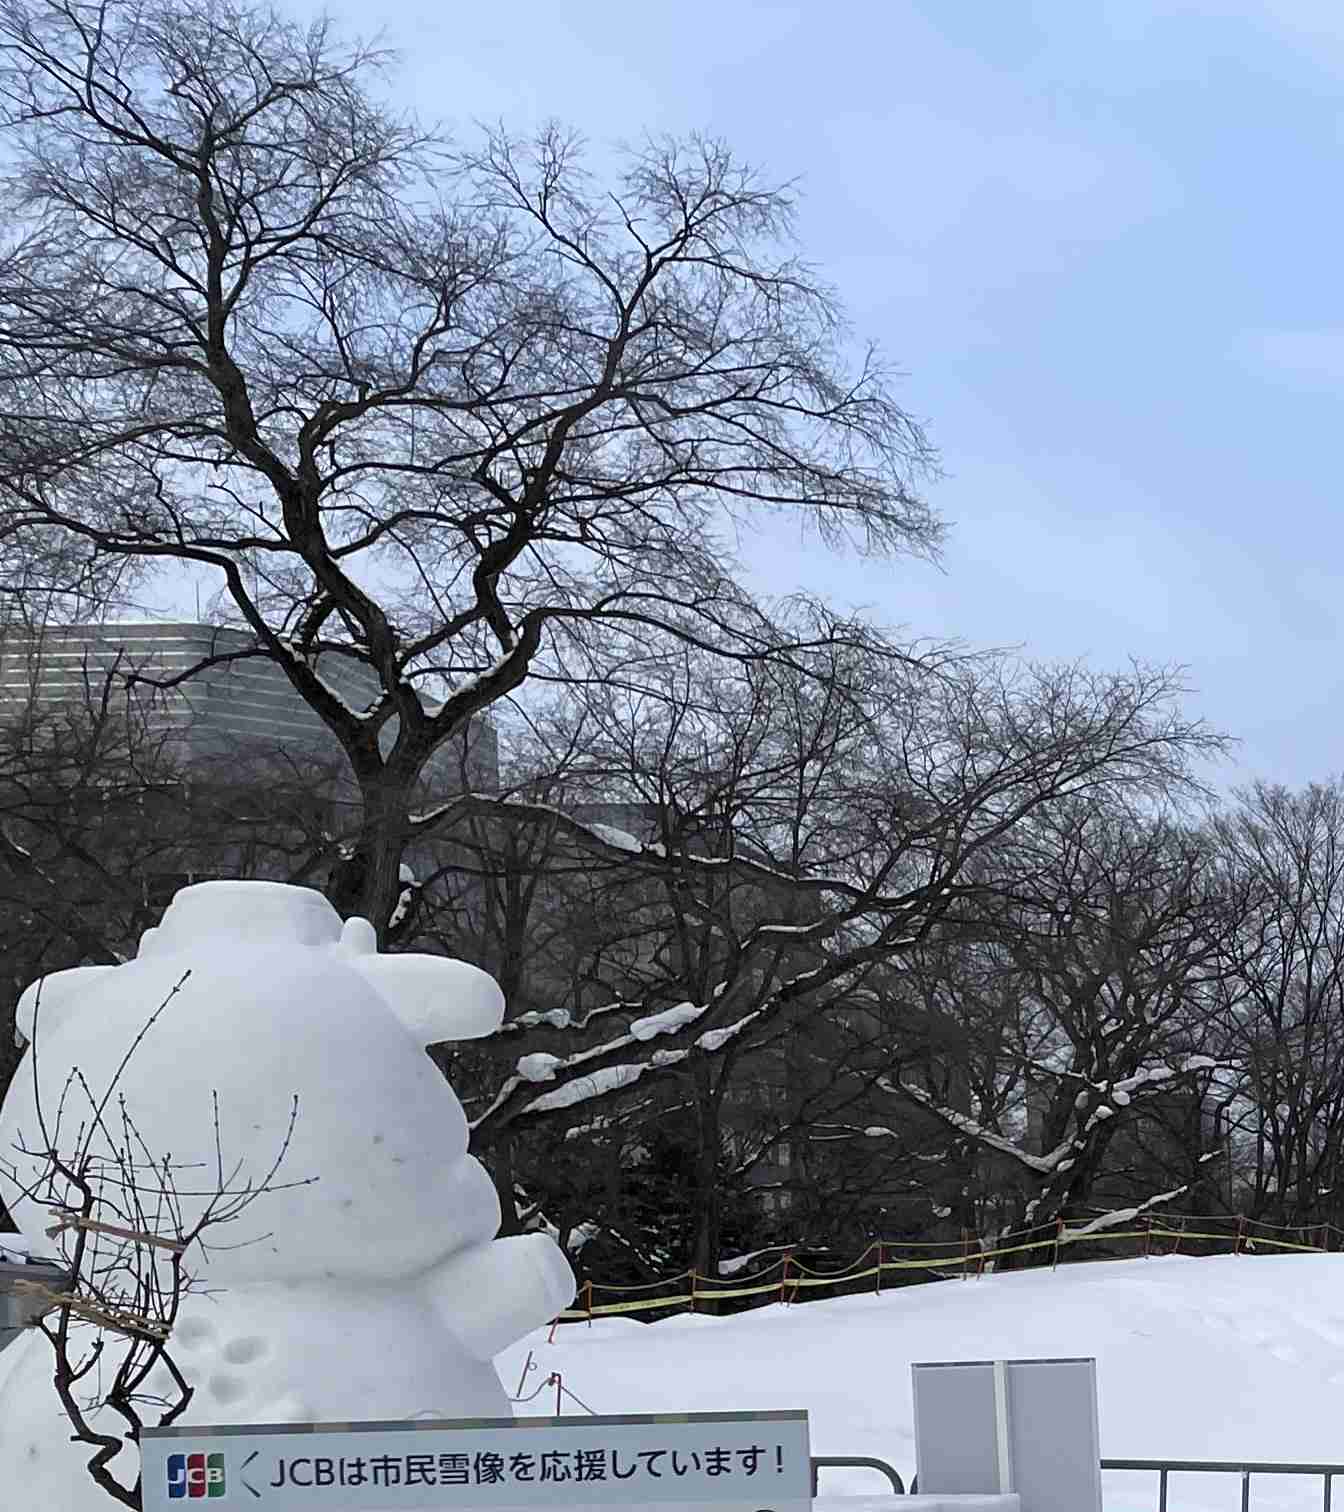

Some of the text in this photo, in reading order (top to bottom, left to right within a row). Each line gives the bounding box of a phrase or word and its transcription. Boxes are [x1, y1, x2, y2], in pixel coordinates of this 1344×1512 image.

[269, 1443, 786, 1489] JCBは市民雪像を応援しています！
